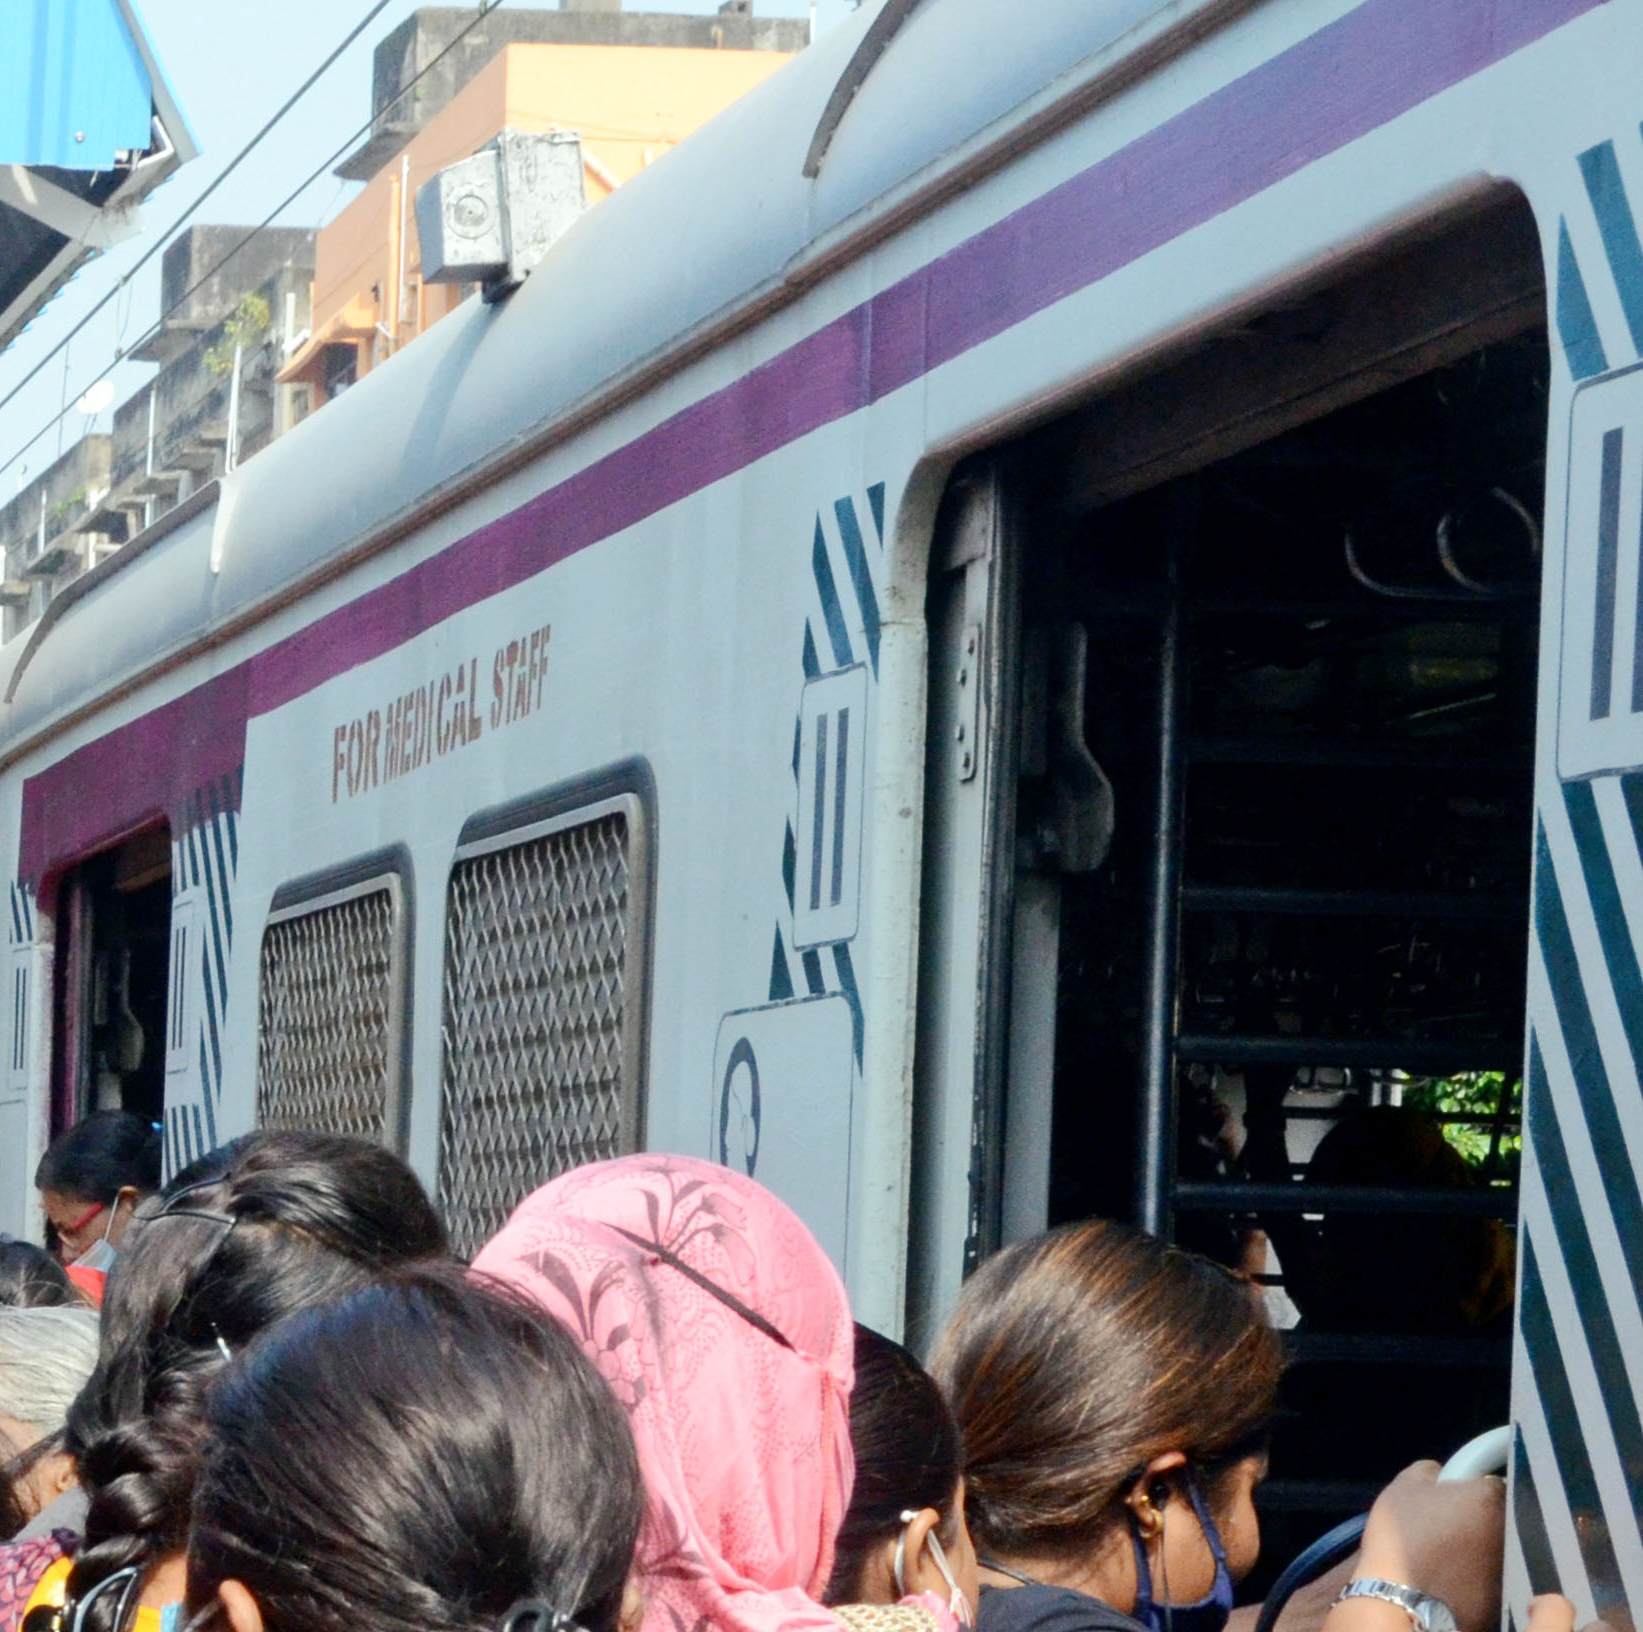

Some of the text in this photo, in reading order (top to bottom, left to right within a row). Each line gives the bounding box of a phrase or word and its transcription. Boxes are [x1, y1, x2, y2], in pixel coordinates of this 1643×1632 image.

[332, 623, 551, 804] FOR MEDICAL STAFF
